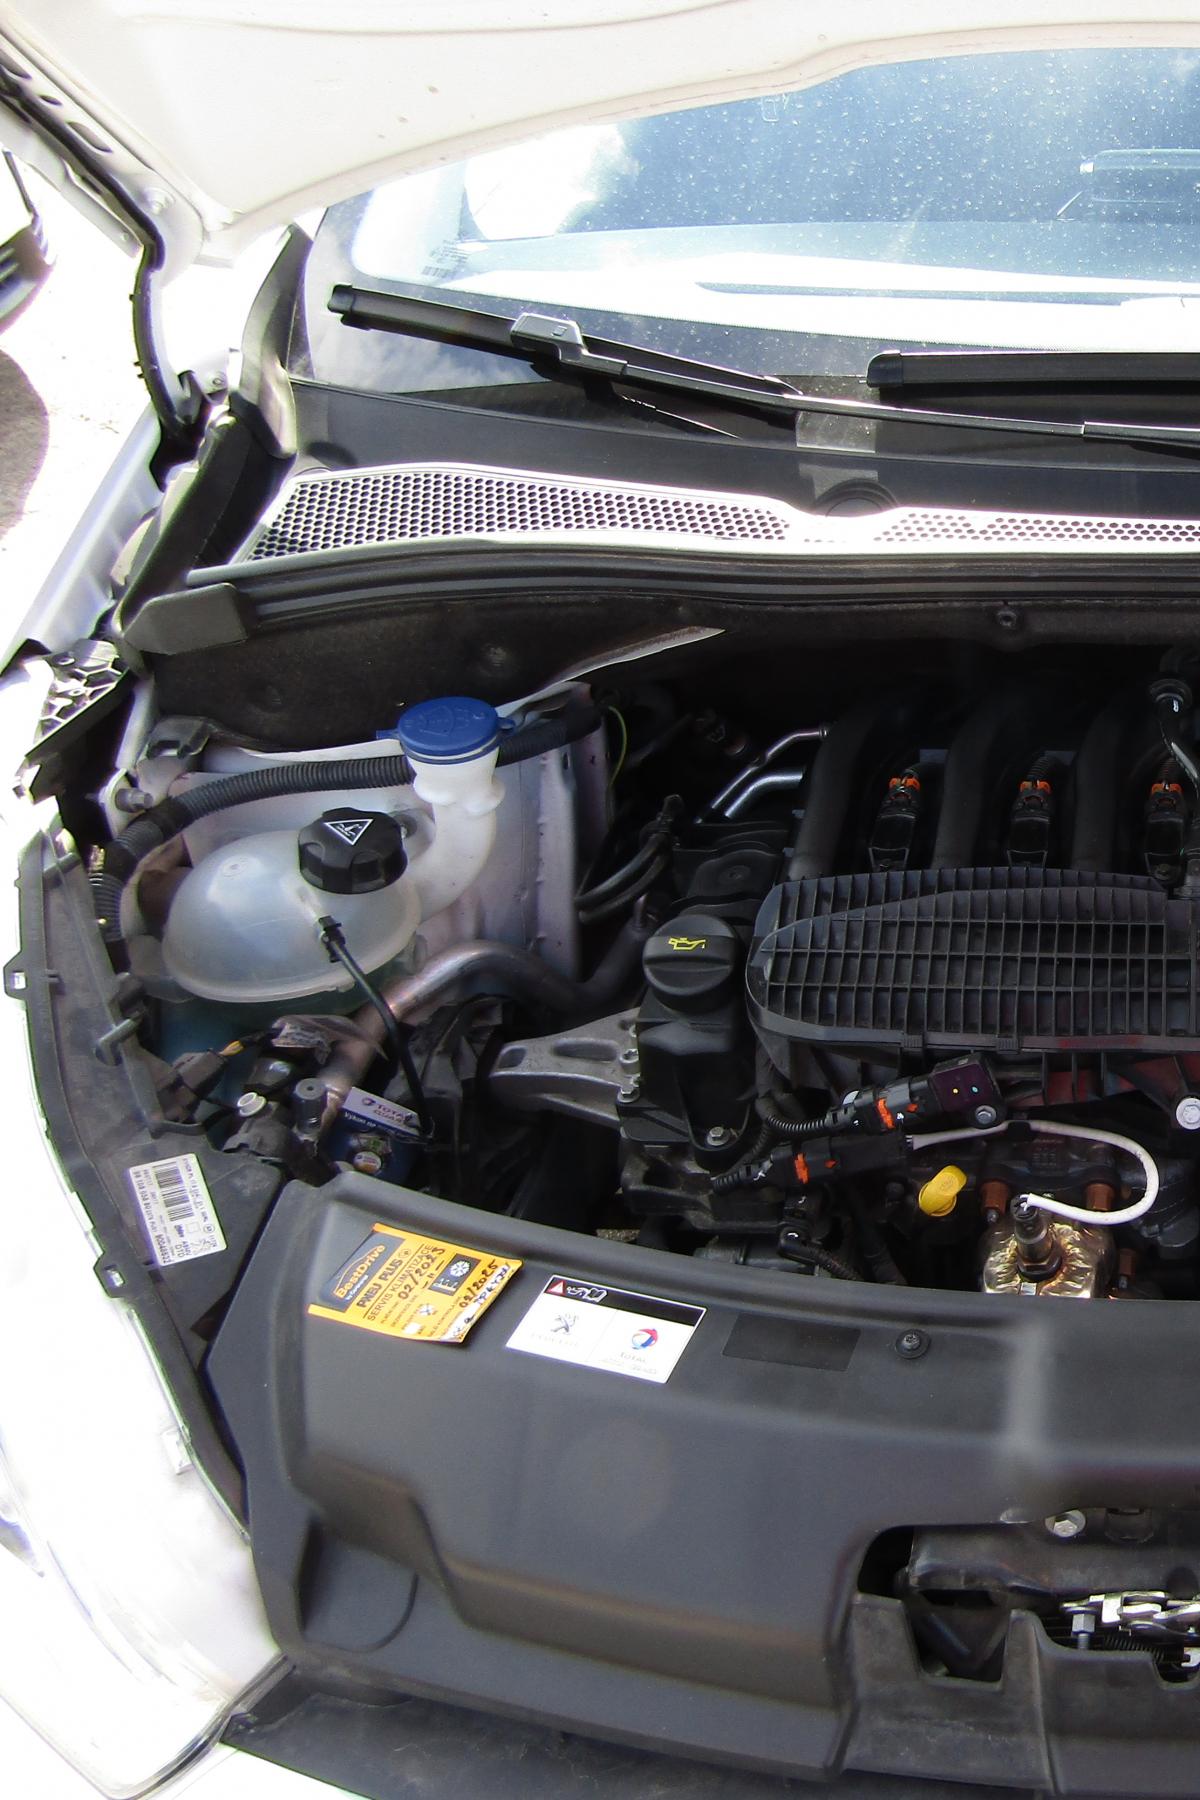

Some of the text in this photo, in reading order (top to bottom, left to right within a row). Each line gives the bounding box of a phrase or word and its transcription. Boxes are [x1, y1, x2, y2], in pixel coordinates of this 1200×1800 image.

[336, 1244, 386, 1298] BestDrive
[367, 1291, 393, 1321] SERVIS
[392, 1245, 434, 1296] KLIMATIZACE
[379, 1259, 403, 1281] PLUS
